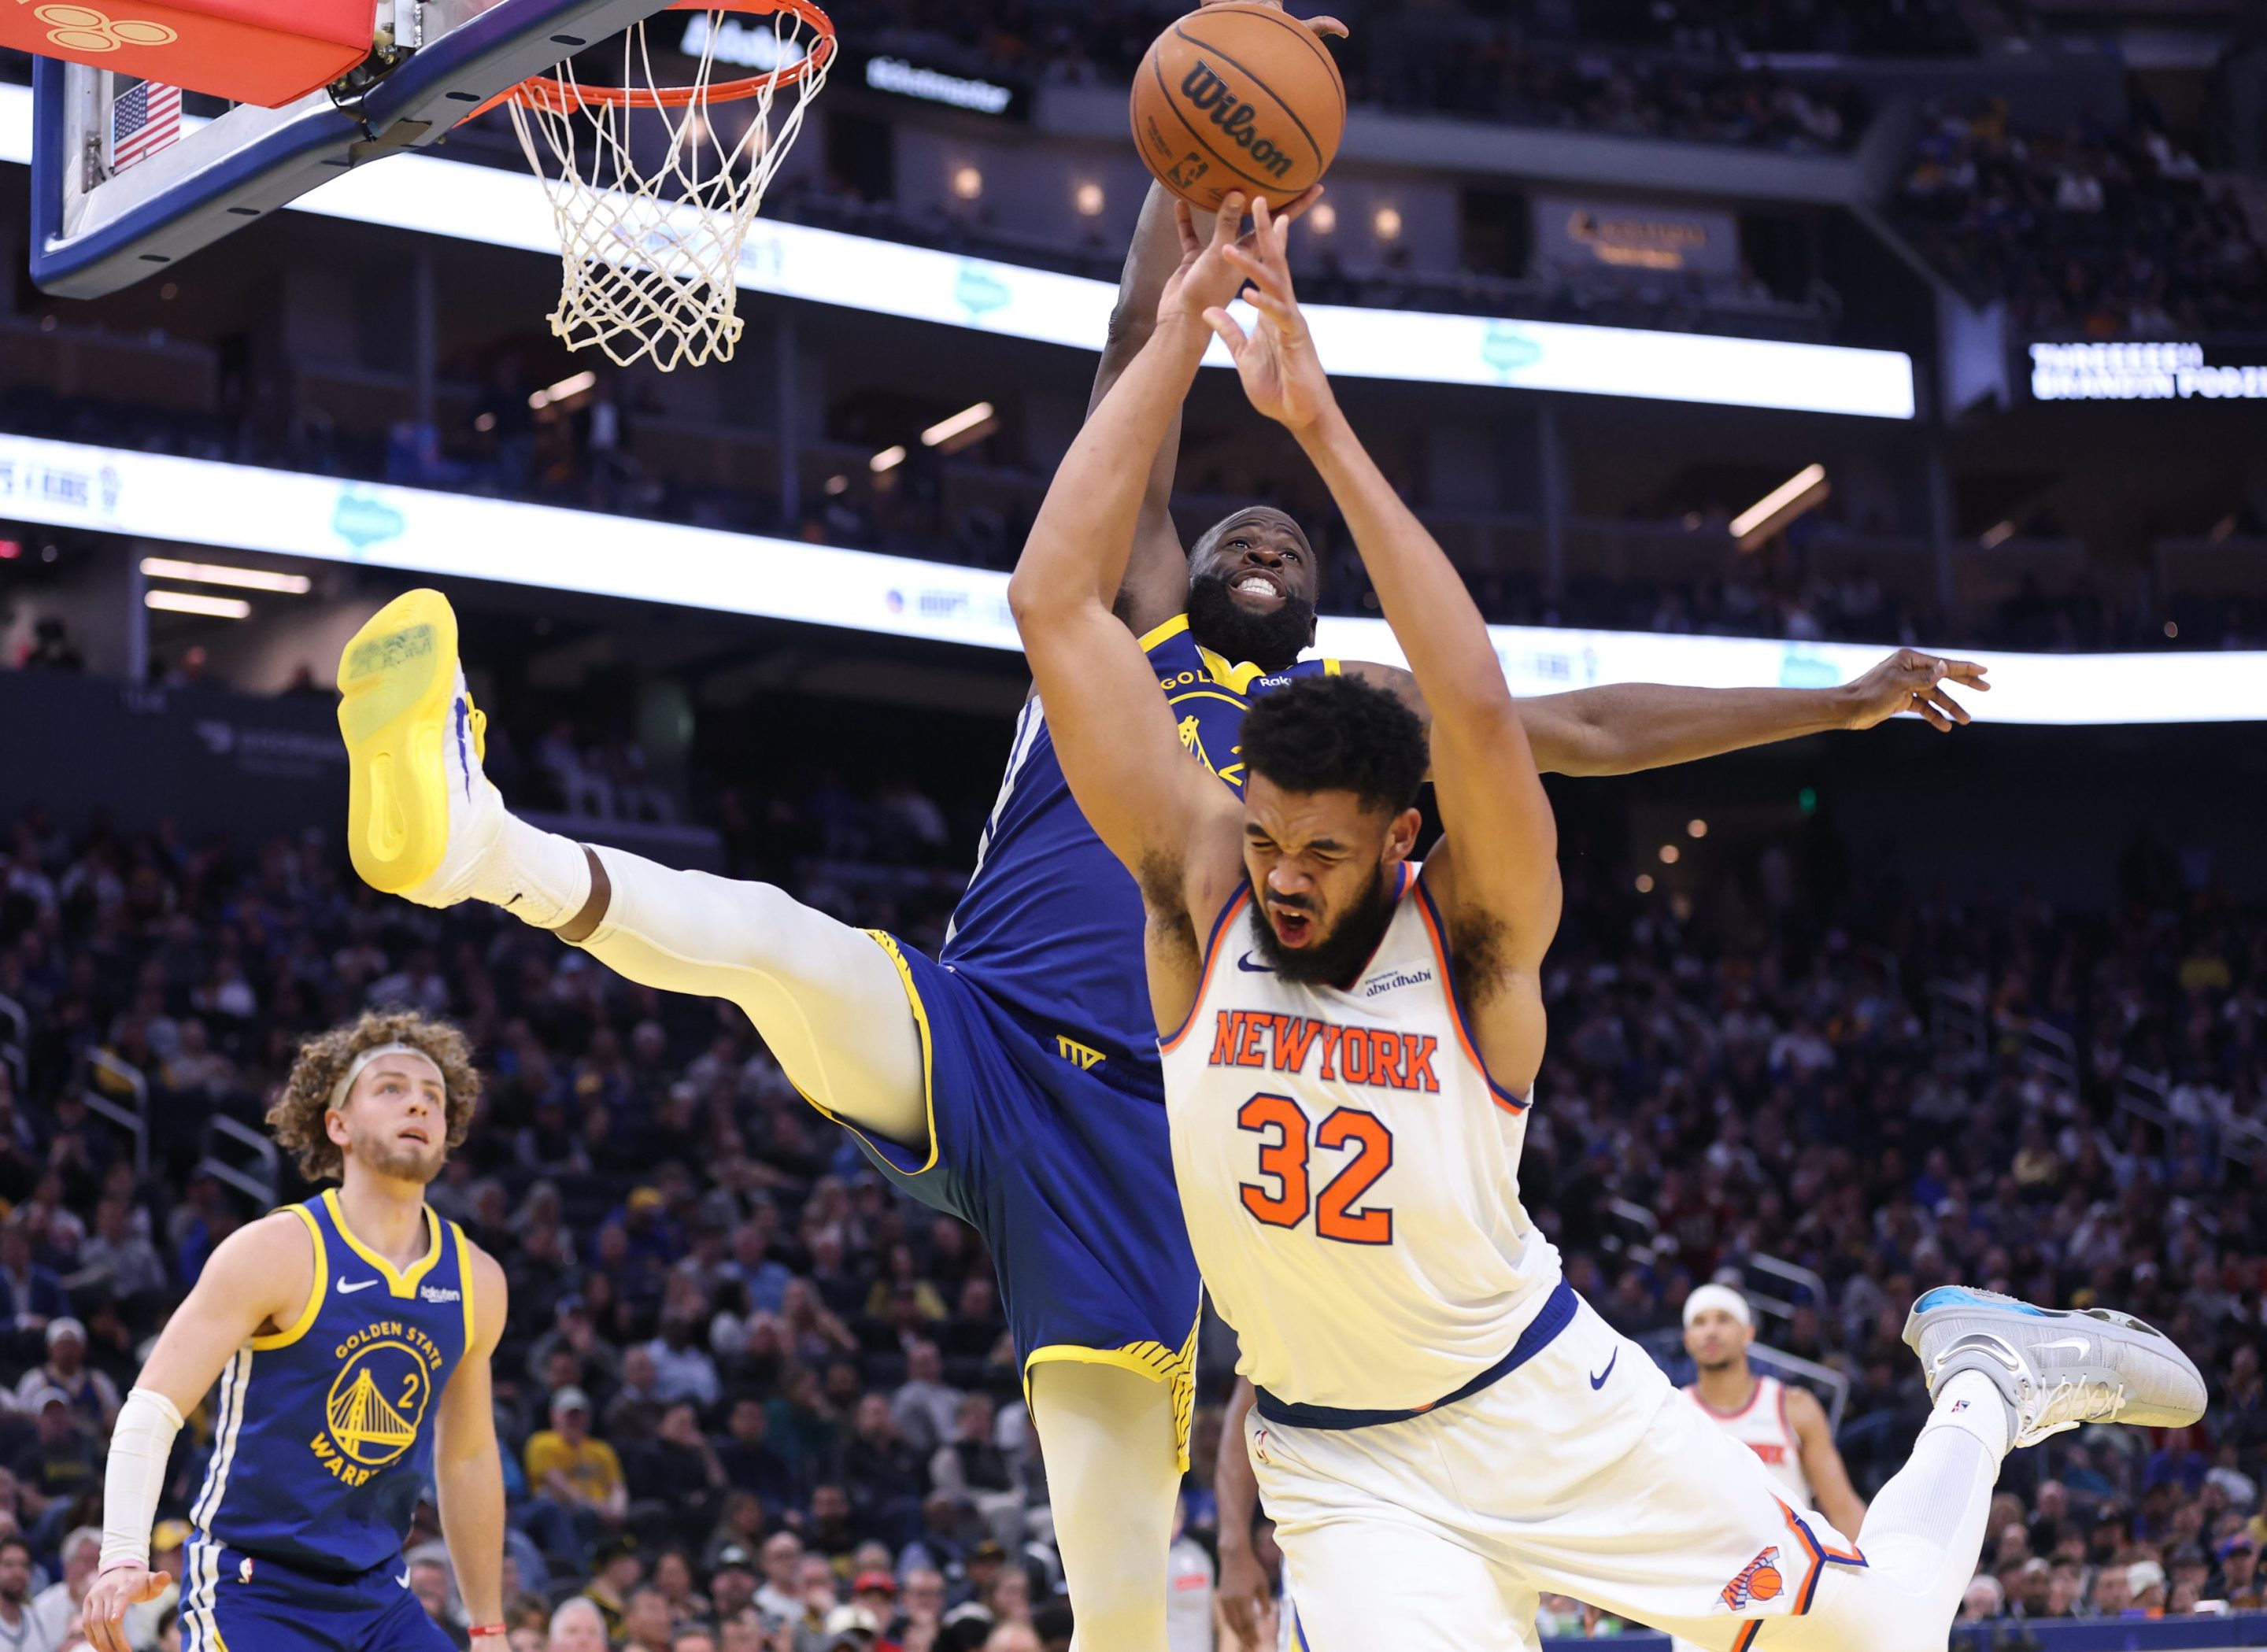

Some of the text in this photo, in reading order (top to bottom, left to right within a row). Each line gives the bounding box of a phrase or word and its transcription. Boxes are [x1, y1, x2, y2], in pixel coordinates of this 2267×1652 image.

[1182, 57, 1293, 180] Wilson
[1160, 670, 1211, 689] GOL
[1366, 969, 1432, 997] abu dhabi
[1208, 1010, 1440, 1094] NEW YORK
[1237, 1092, 1392, 1245] 32
[335, 1321, 443, 1370] GOLDEN STATE
[398, 1373, 419, 1408] 2
[310, 1431, 371, 1487] WARR
